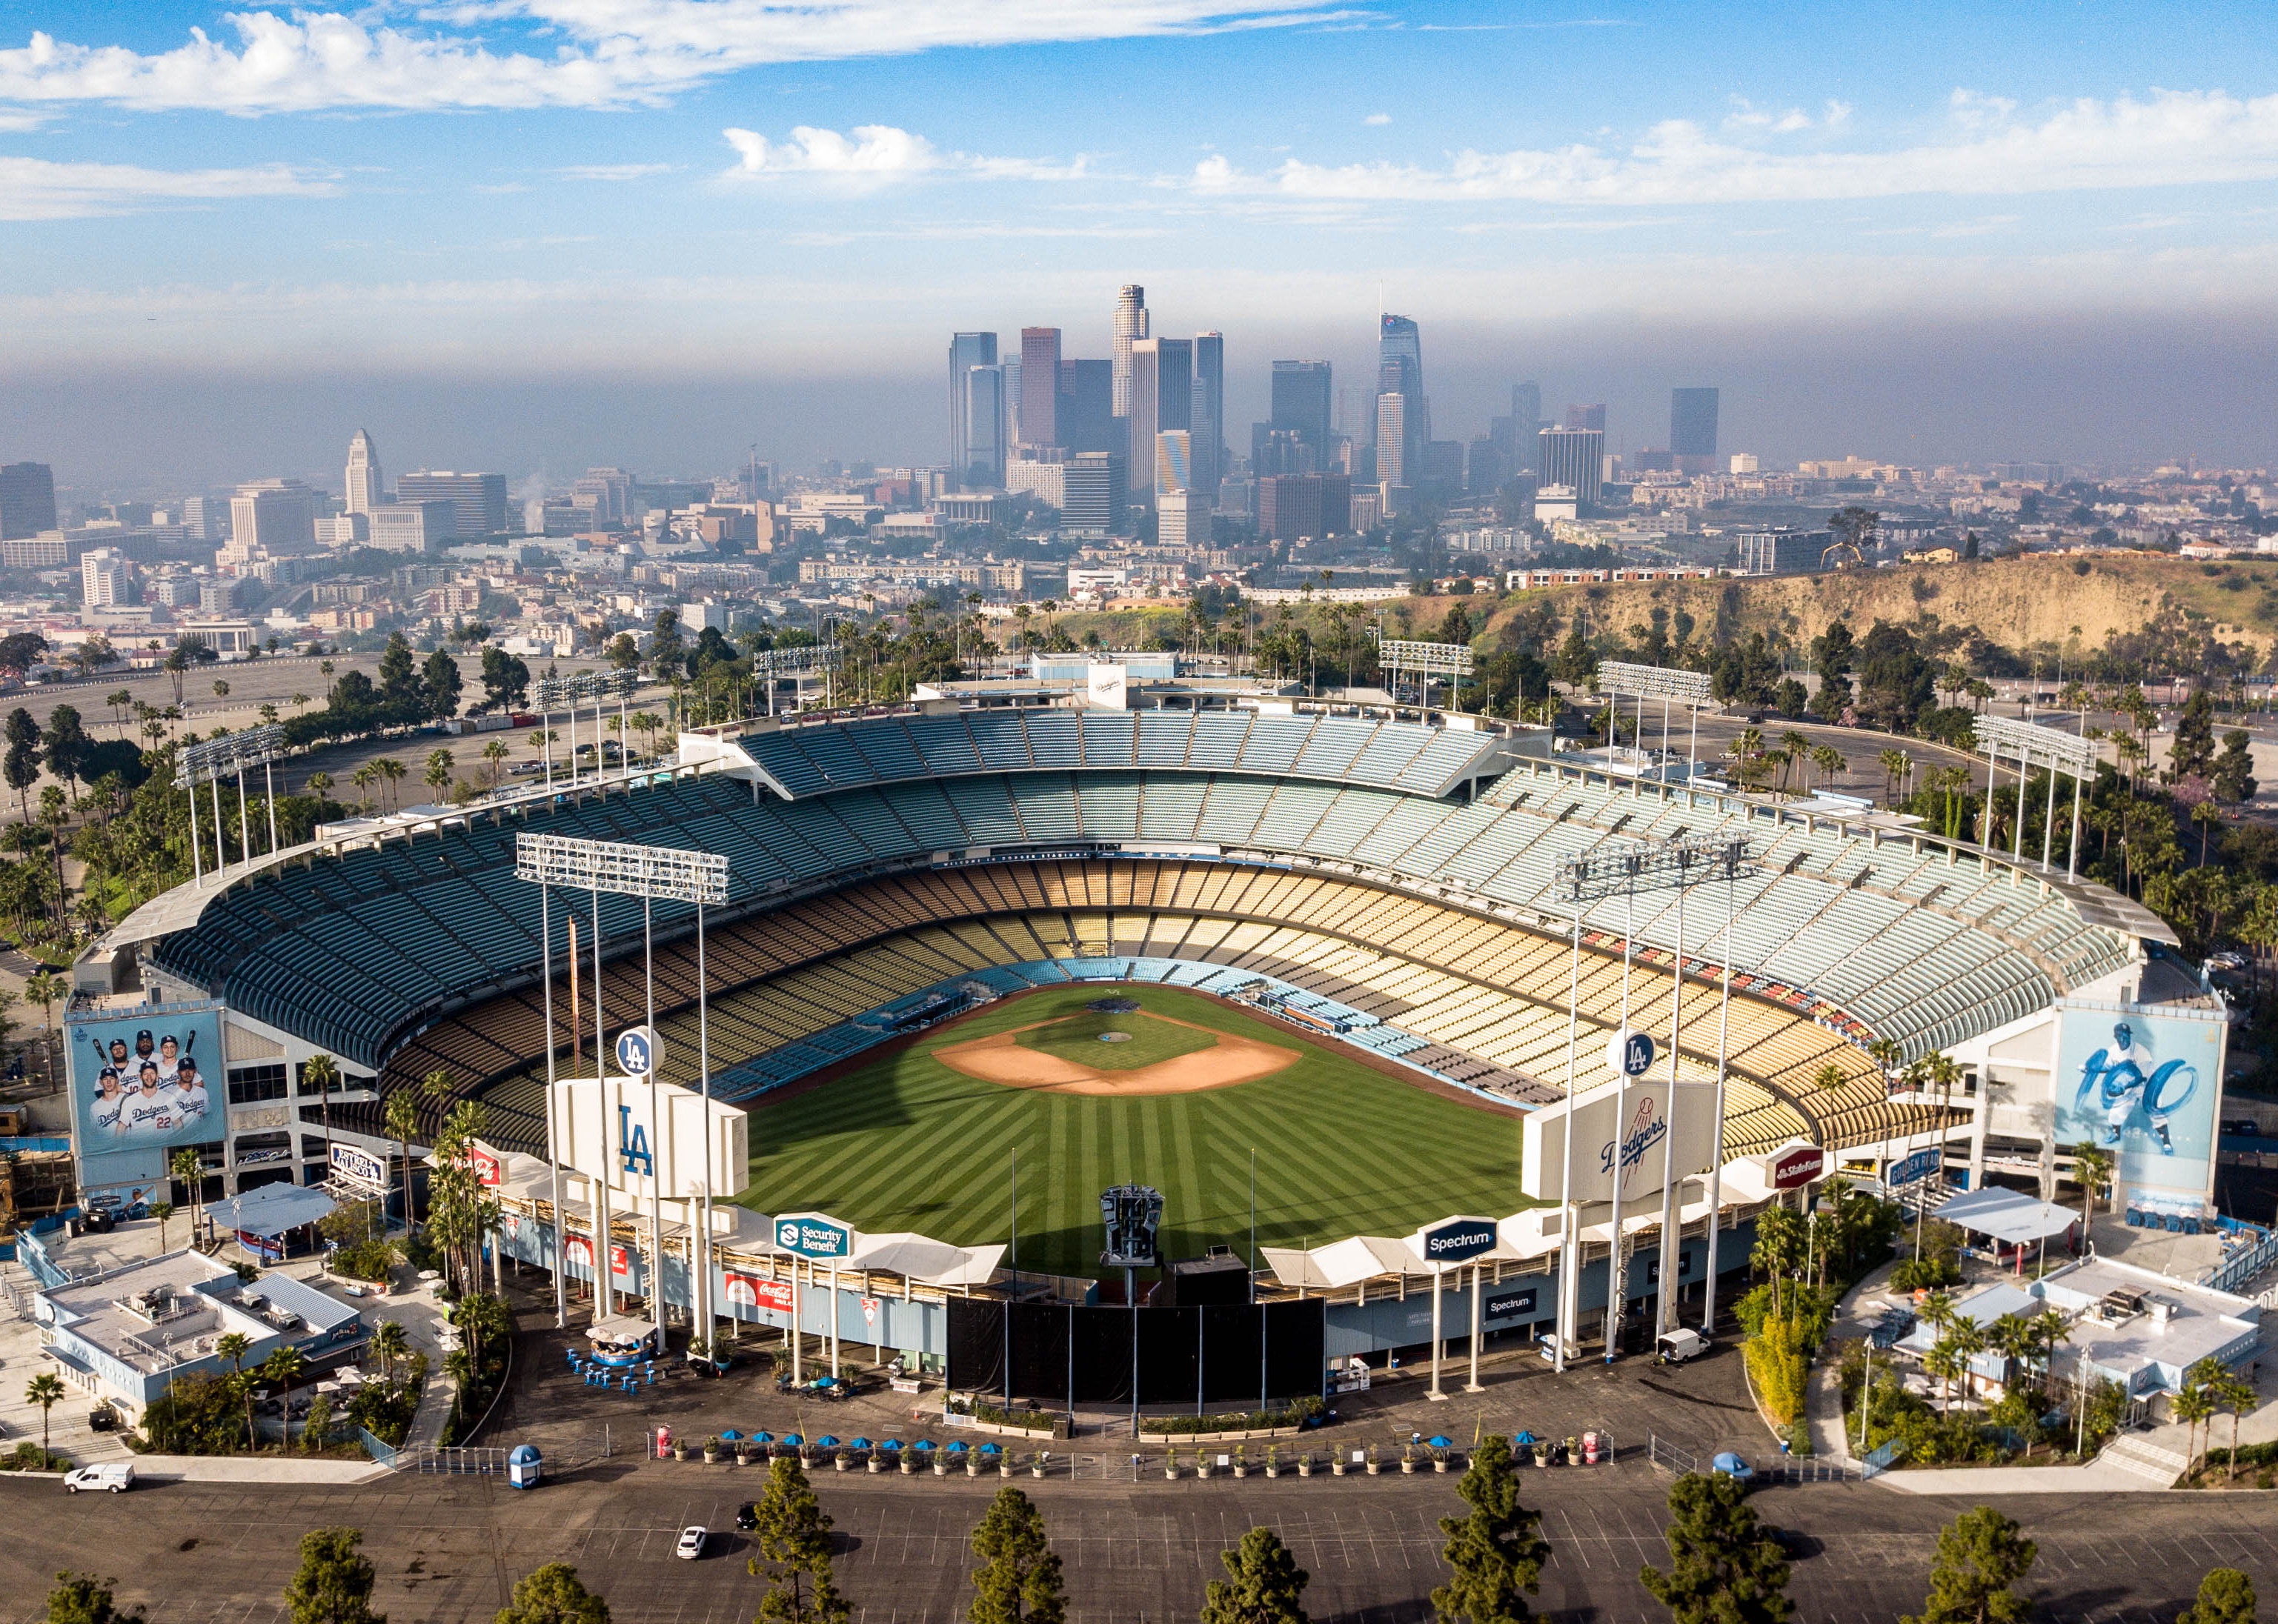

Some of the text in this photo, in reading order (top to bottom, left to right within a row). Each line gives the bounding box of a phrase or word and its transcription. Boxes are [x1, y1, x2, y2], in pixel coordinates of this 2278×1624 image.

[625, 1036, 645, 1071] LA
[1629, 1040, 1647, 1071] LA
[98, 1108, 120, 1127] Dodg
[132, 1105, 169, 1122] Dodgers
[156, 1116, 171, 1129] 22
[618, 1105, 653, 1177] LA
[1601, 1116, 1667, 1174] Dodgers
[335, 1157, 369, 1177] JALISCO
[338, 1149, 376, 1176] ESTRELLA
[1892, 1157, 1919, 1183] GOLDEN
[802, 1225, 843, 1244] Security
[1430, 1232, 1490, 1252] Spectrum
[802, 1237, 837, 1253] Benefit
[774, 1298, 793, 1307] PAVILIO
[1490, 1297, 1529, 1313] Spectrum
